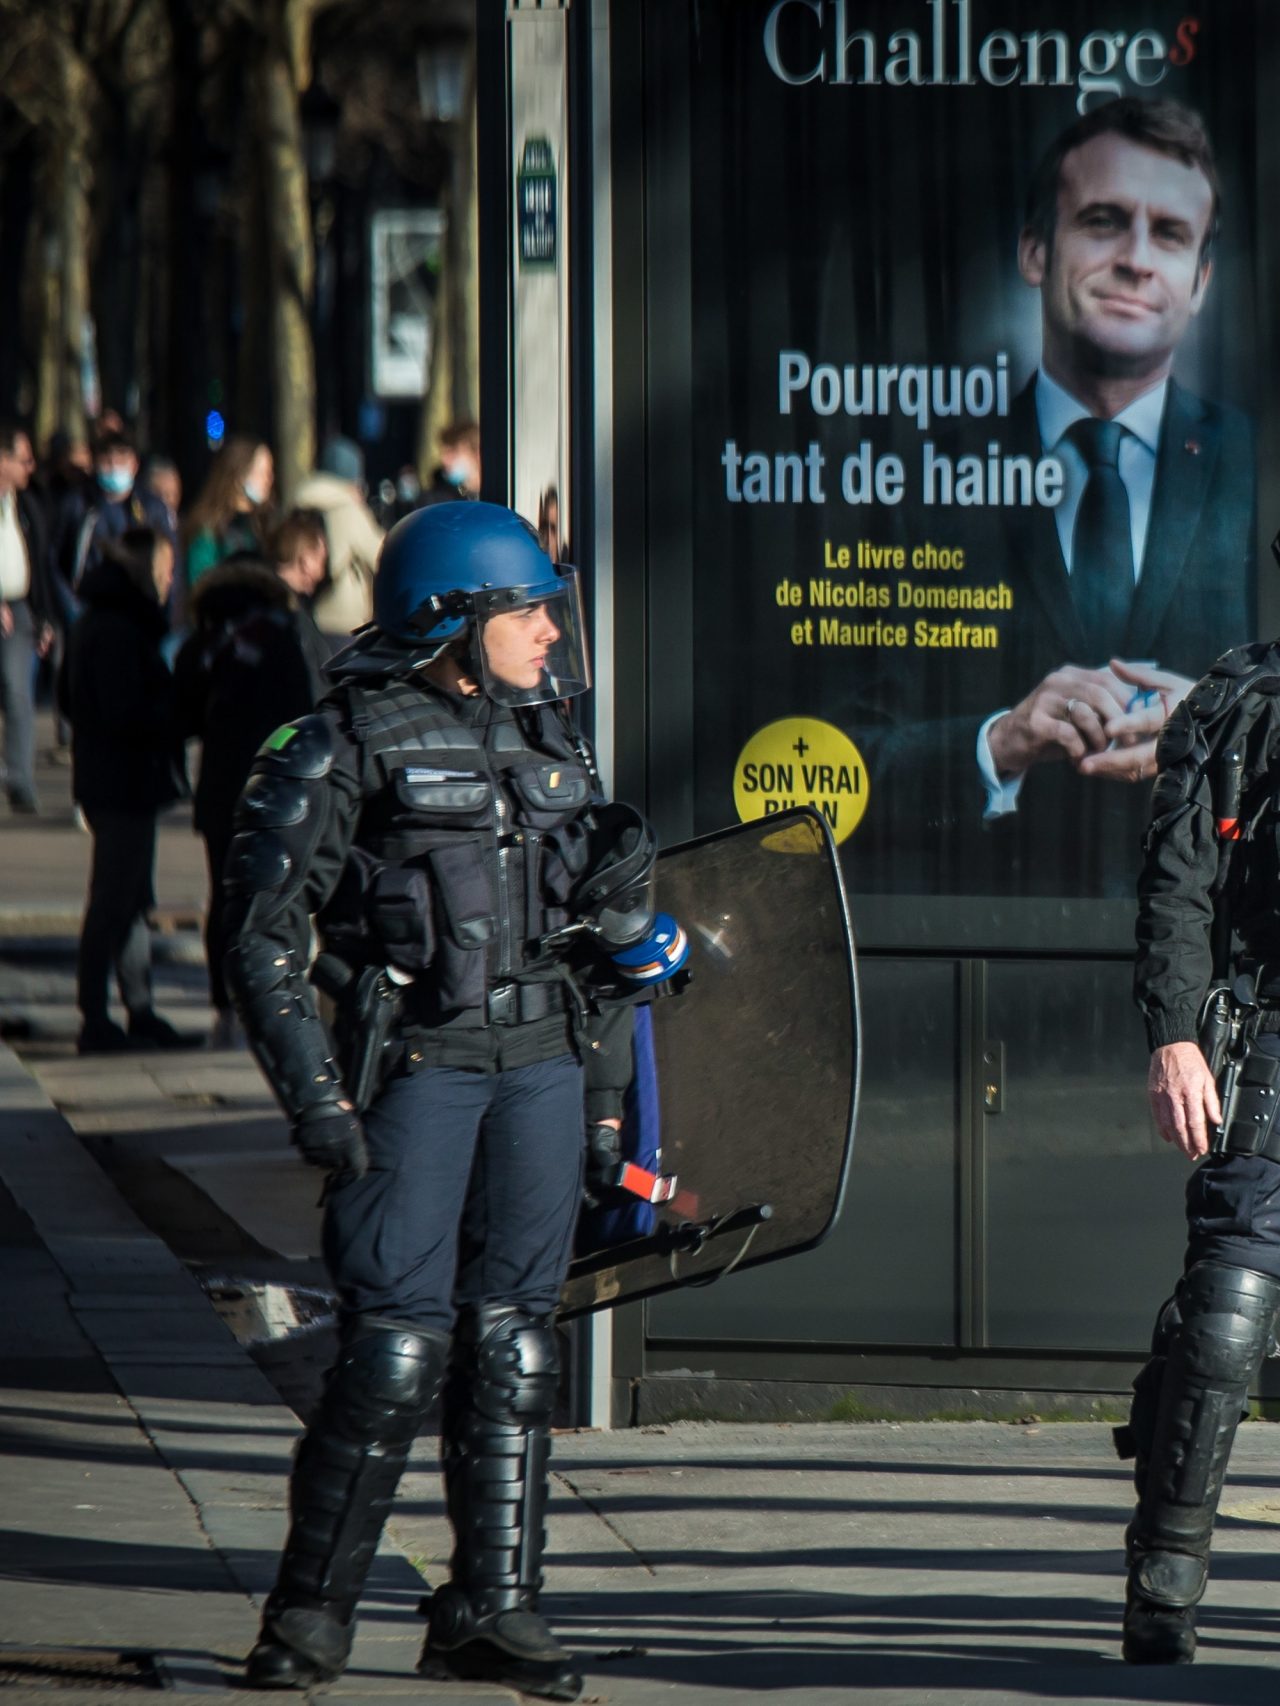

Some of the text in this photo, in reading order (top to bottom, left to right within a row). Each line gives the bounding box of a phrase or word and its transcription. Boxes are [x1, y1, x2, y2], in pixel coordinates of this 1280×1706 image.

[763, 0, 1200, 115] Challenges
[779, 350, 1008, 430] Pourquoi
[721, 440, 1064, 507] tant de haine
[824, 541, 965, 570] Le livre choc
[776, 578, 1013, 610] de Nicolas Domenach
[791, 617, 998, 647] et Maurice Szafran
[743, 764, 860, 794] SON VRAI
